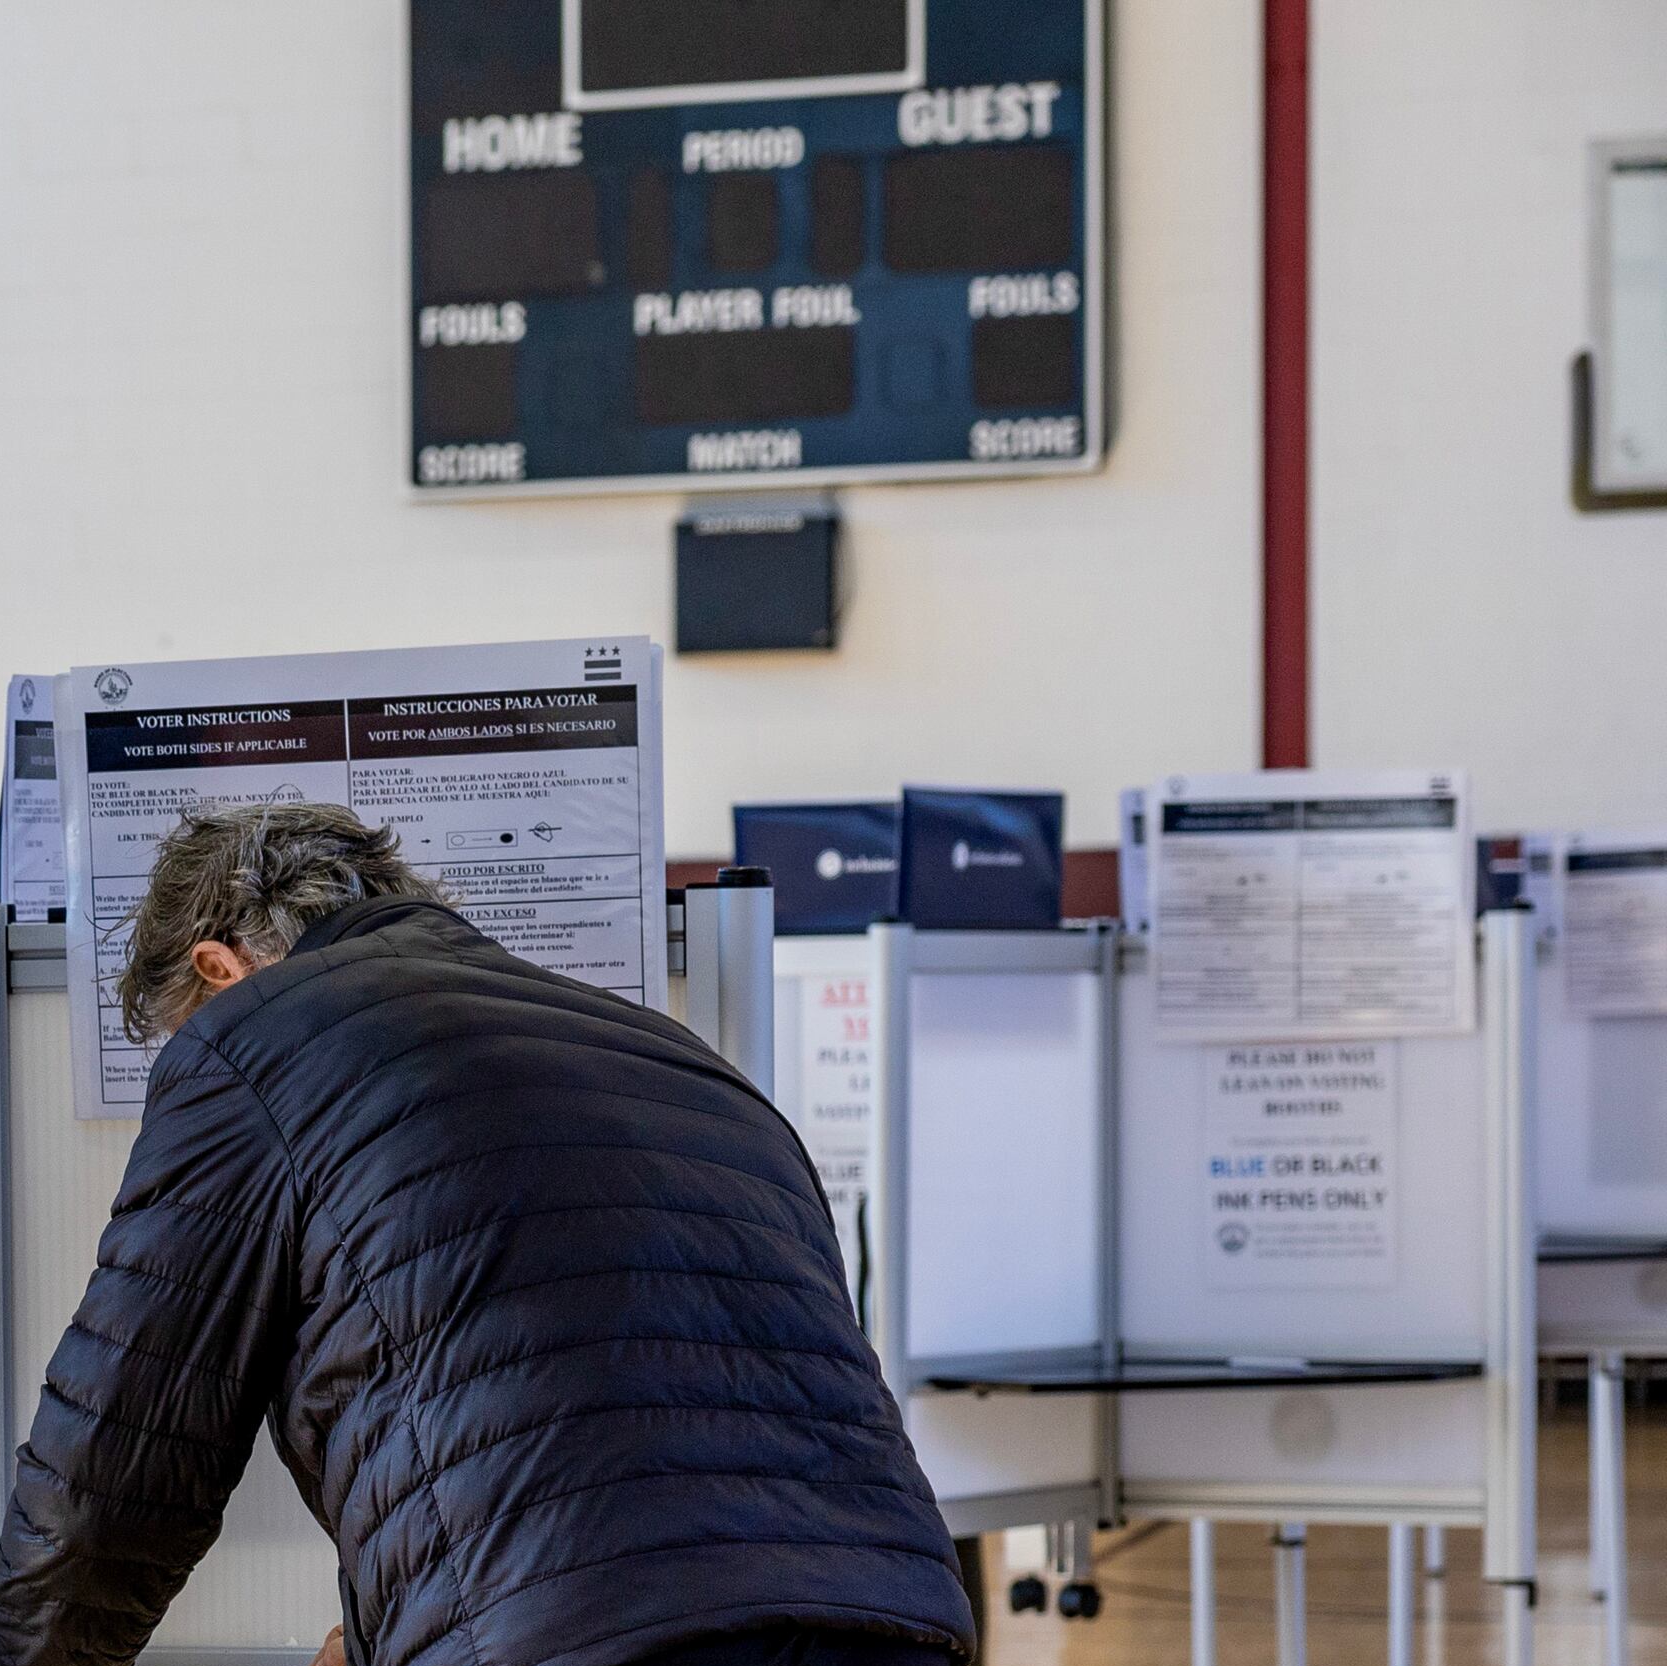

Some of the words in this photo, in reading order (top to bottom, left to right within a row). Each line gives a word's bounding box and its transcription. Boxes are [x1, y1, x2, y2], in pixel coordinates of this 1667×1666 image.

[897, 83, 1060, 145] GUEST
[443, 114, 583, 172] HOME
[684, 128, 803, 172] PERIOD
[634, 291, 763, 334] PLAYER
[773, 285, 861, 327] FOUL
[970, 273, 1080, 316] FOULS
[420, 302, 526, 346] FOULS
[689, 431, 801, 470] MATCH
[971, 418, 1080, 459] SCORE
[420, 444, 525, 481] SCORE
[137, 715, 184, 729] VOTER
[188, 709, 291, 726] INSTRUCTIONS
[384, 699, 502, 716] INSTRUCCIONES
[504, 696, 544, 710] PARA
[546, 693, 598, 708] VOTAR
[368, 730, 400, 742] VOTE
[402, 728, 426, 740] POR
[428, 726, 470, 739] AMBOS
[474, 724, 514, 736] LADOS
[516, 723, 528, 734] SI
[530, 722, 544, 733] ES
[546, 719, 616, 732] NECESARIO
[124, 746, 154, 757] VOTE
[157, 744, 187, 756] BOTH
[190, 743, 221, 754] SIDES
[224, 741, 233, 752] IF
[234, 738, 307, 751] APPLICABLE
[353, 770, 376, 778] PARA
[498, 772, 530, 780] NEGRO
[354, 796, 416, 806] PREFERENCIA
[419, 795, 448, 803] COMO
[478, 791, 522, 800] MUESTRA
[1211, 1157, 1265, 1177] BLUE
[1273, 1156, 1303, 1175] OR
[1311, 1154, 1381, 1176] BLACK
[1217, 1192, 1250, 1209] INK
[1260, 1191, 1316, 1209] PENS
[1324, 1189, 1385, 1209] ONLY
